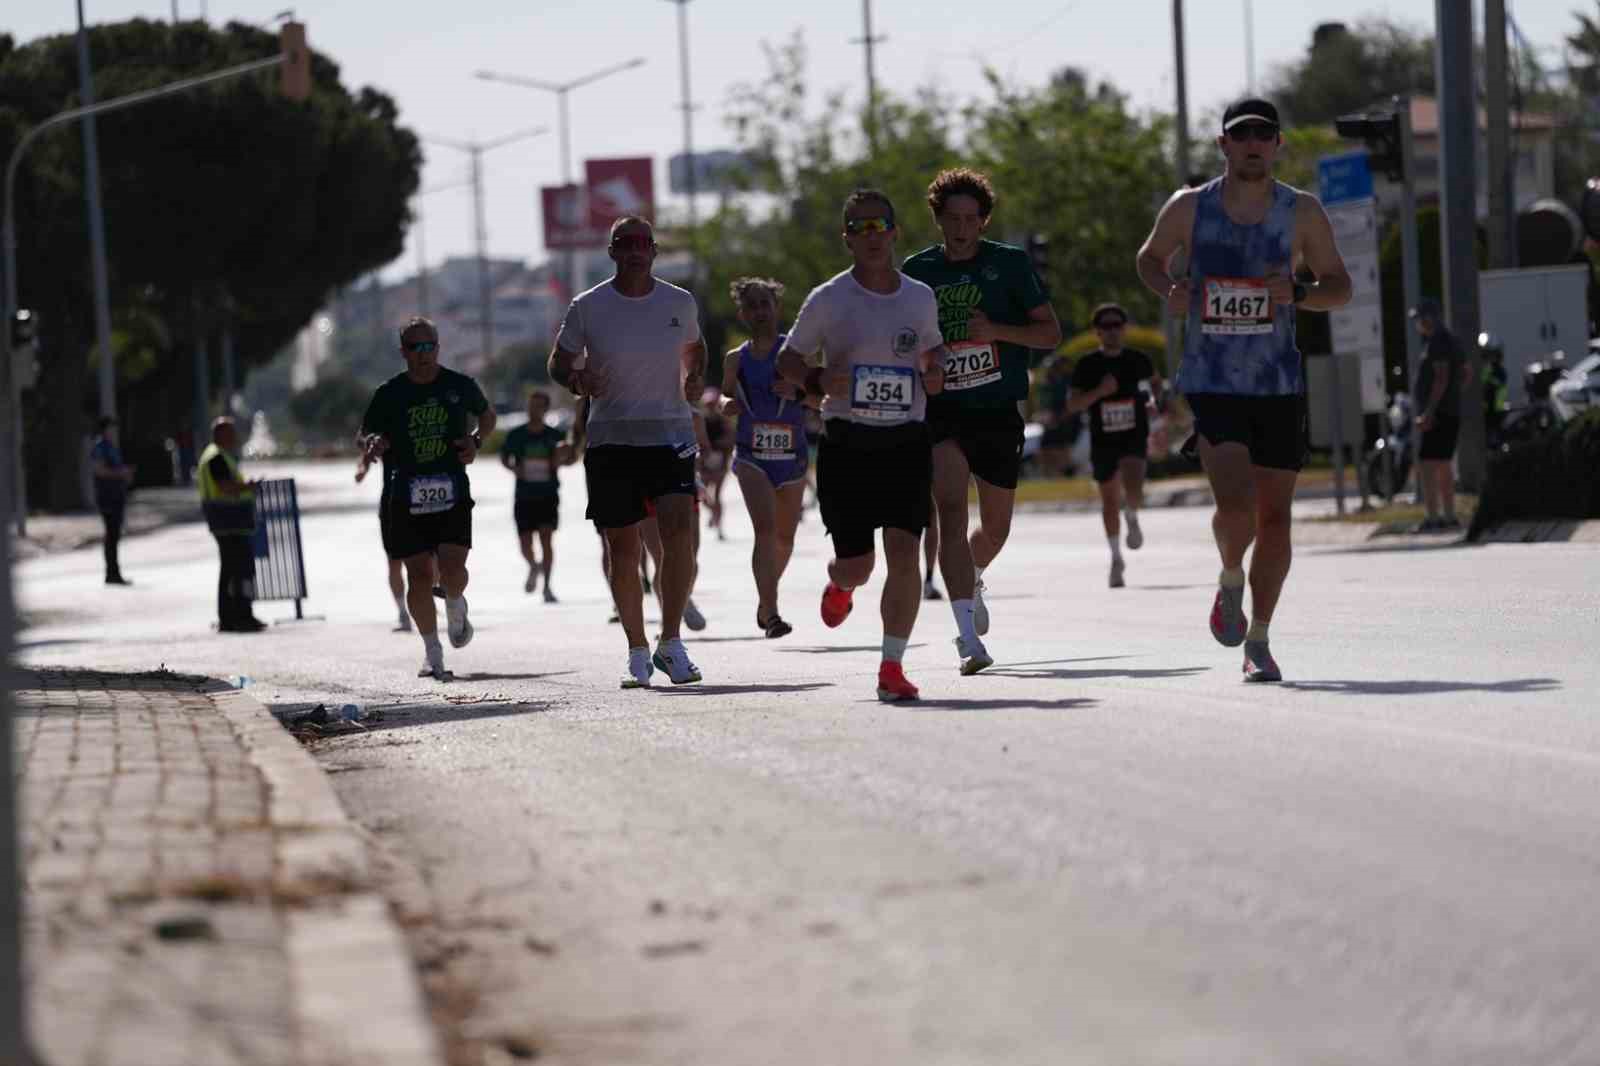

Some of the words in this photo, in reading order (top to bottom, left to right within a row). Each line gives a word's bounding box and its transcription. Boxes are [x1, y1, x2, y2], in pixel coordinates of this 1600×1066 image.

[1211, 296, 1265, 316] 1467
[946, 352, 992, 375] 2702
[866, 381, 904, 402] 354
[756, 434, 789, 448] 2188
[419, 488, 447, 503] 320
